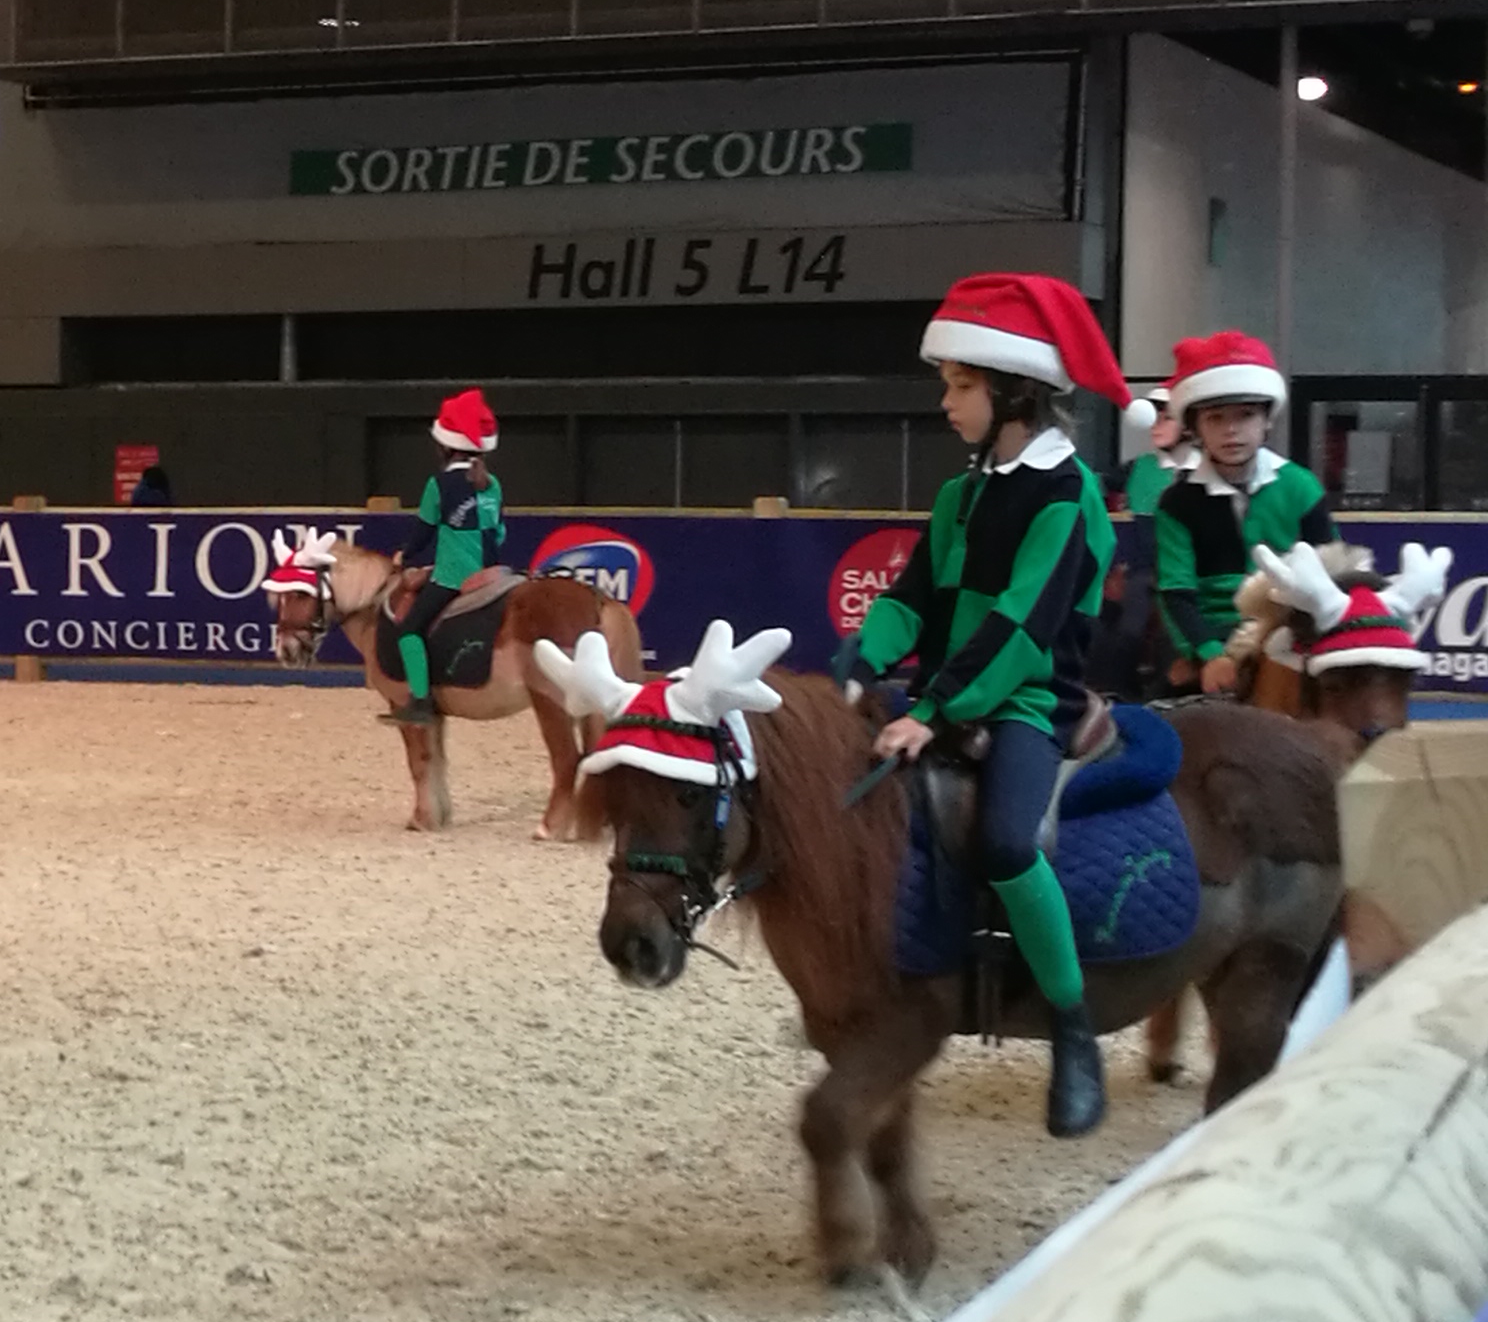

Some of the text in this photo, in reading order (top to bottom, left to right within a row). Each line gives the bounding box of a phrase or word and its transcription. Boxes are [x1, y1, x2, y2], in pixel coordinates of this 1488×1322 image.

[330, 127, 868, 195] SORTIE DE SECOURS
[527, 234, 847, 300] Hall 5 L14
[841, 569, 900, 590] SAL
